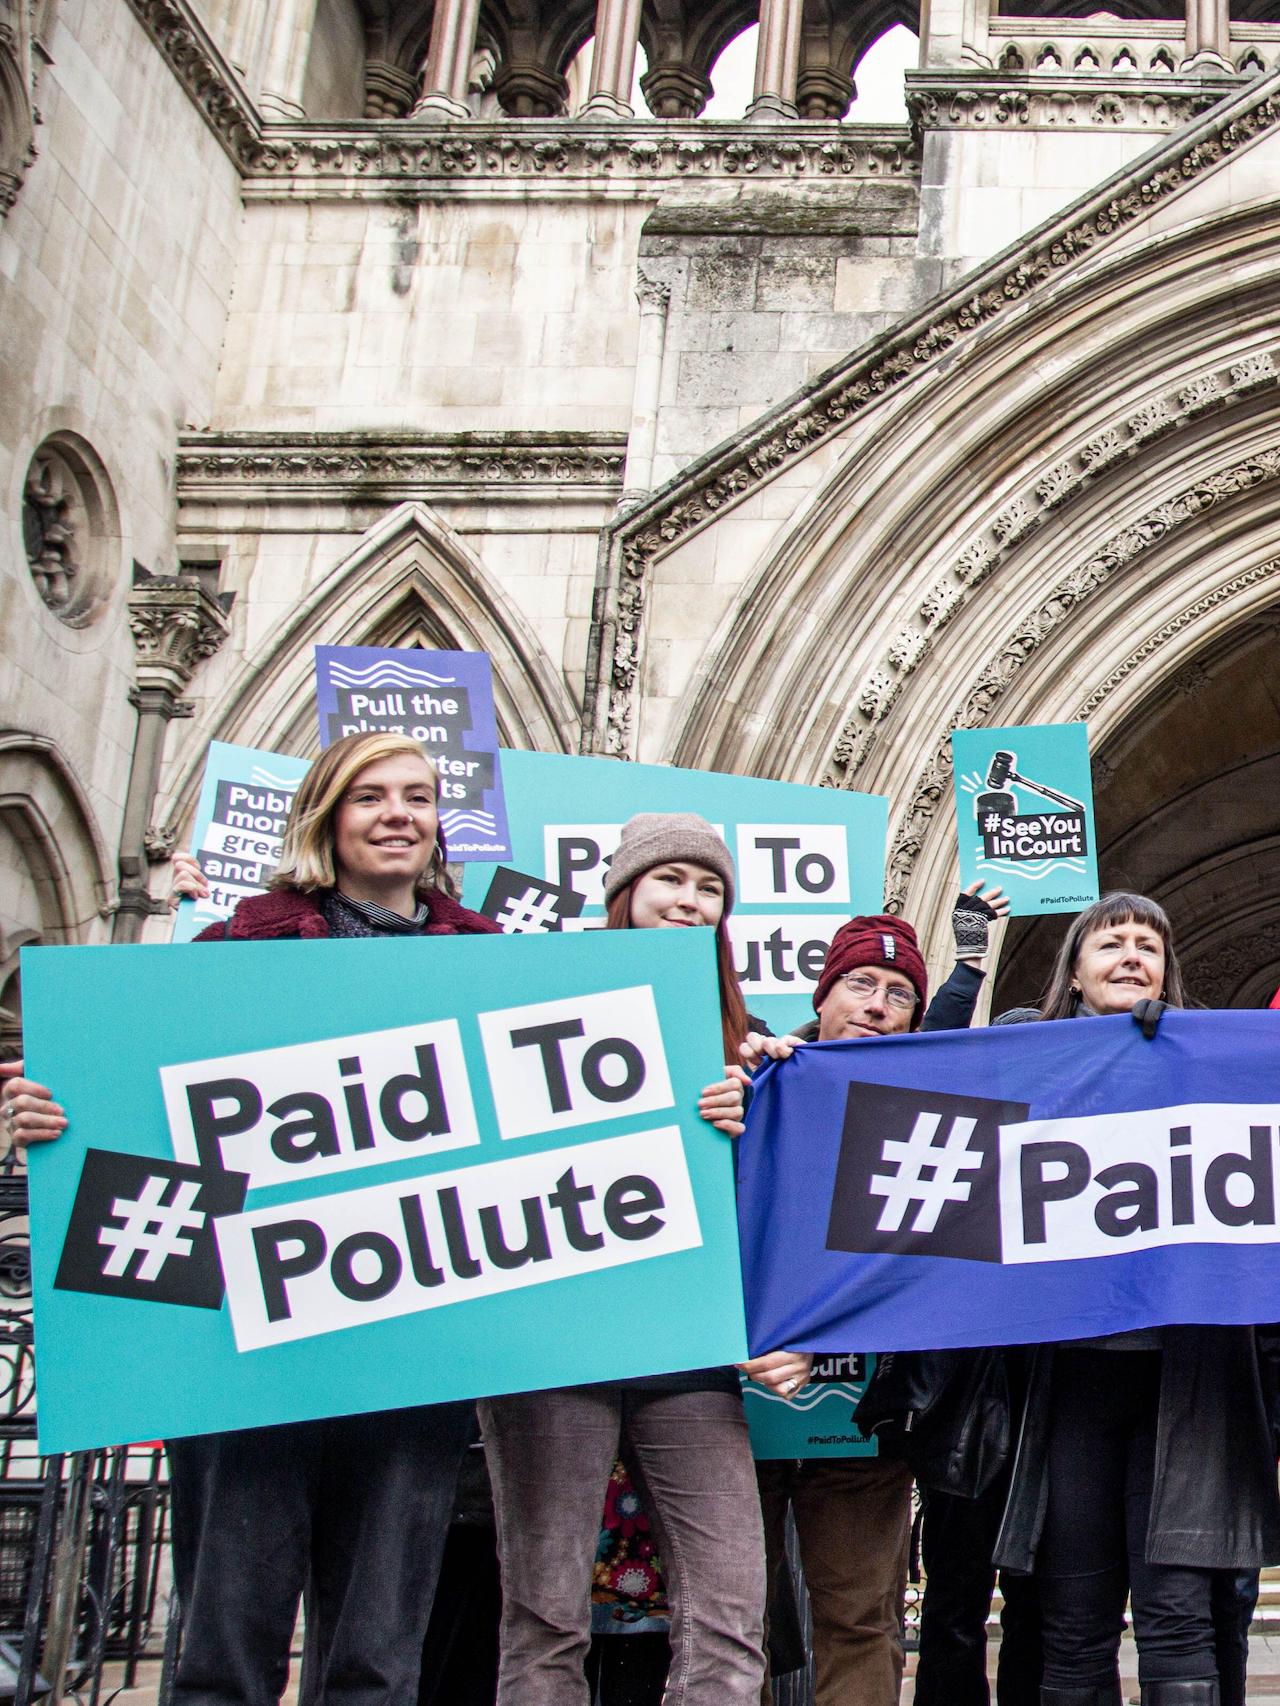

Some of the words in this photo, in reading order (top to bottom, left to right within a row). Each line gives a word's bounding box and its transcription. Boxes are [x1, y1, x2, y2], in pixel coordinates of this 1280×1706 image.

[351, 694, 406, 716] Pull
[412, 694, 458, 715] the
[412, 725, 447, 742] on
[437, 755, 480, 777] ter
[984, 813, 1081, 837] #SeeYou
[993, 835, 1081, 856] InCourt
[204, 859, 263, 883] and
[755, 837, 835, 894] To
[212, 888, 240, 906] tr
[1040, 896, 1094, 904] #PaidToPollute
[735, 927, 832, 982] ute
[186, 1043, 451, 1175] Paid
[510, 1017, 646, 1113] To
[251, 1165, 666, 1324] Pollute
